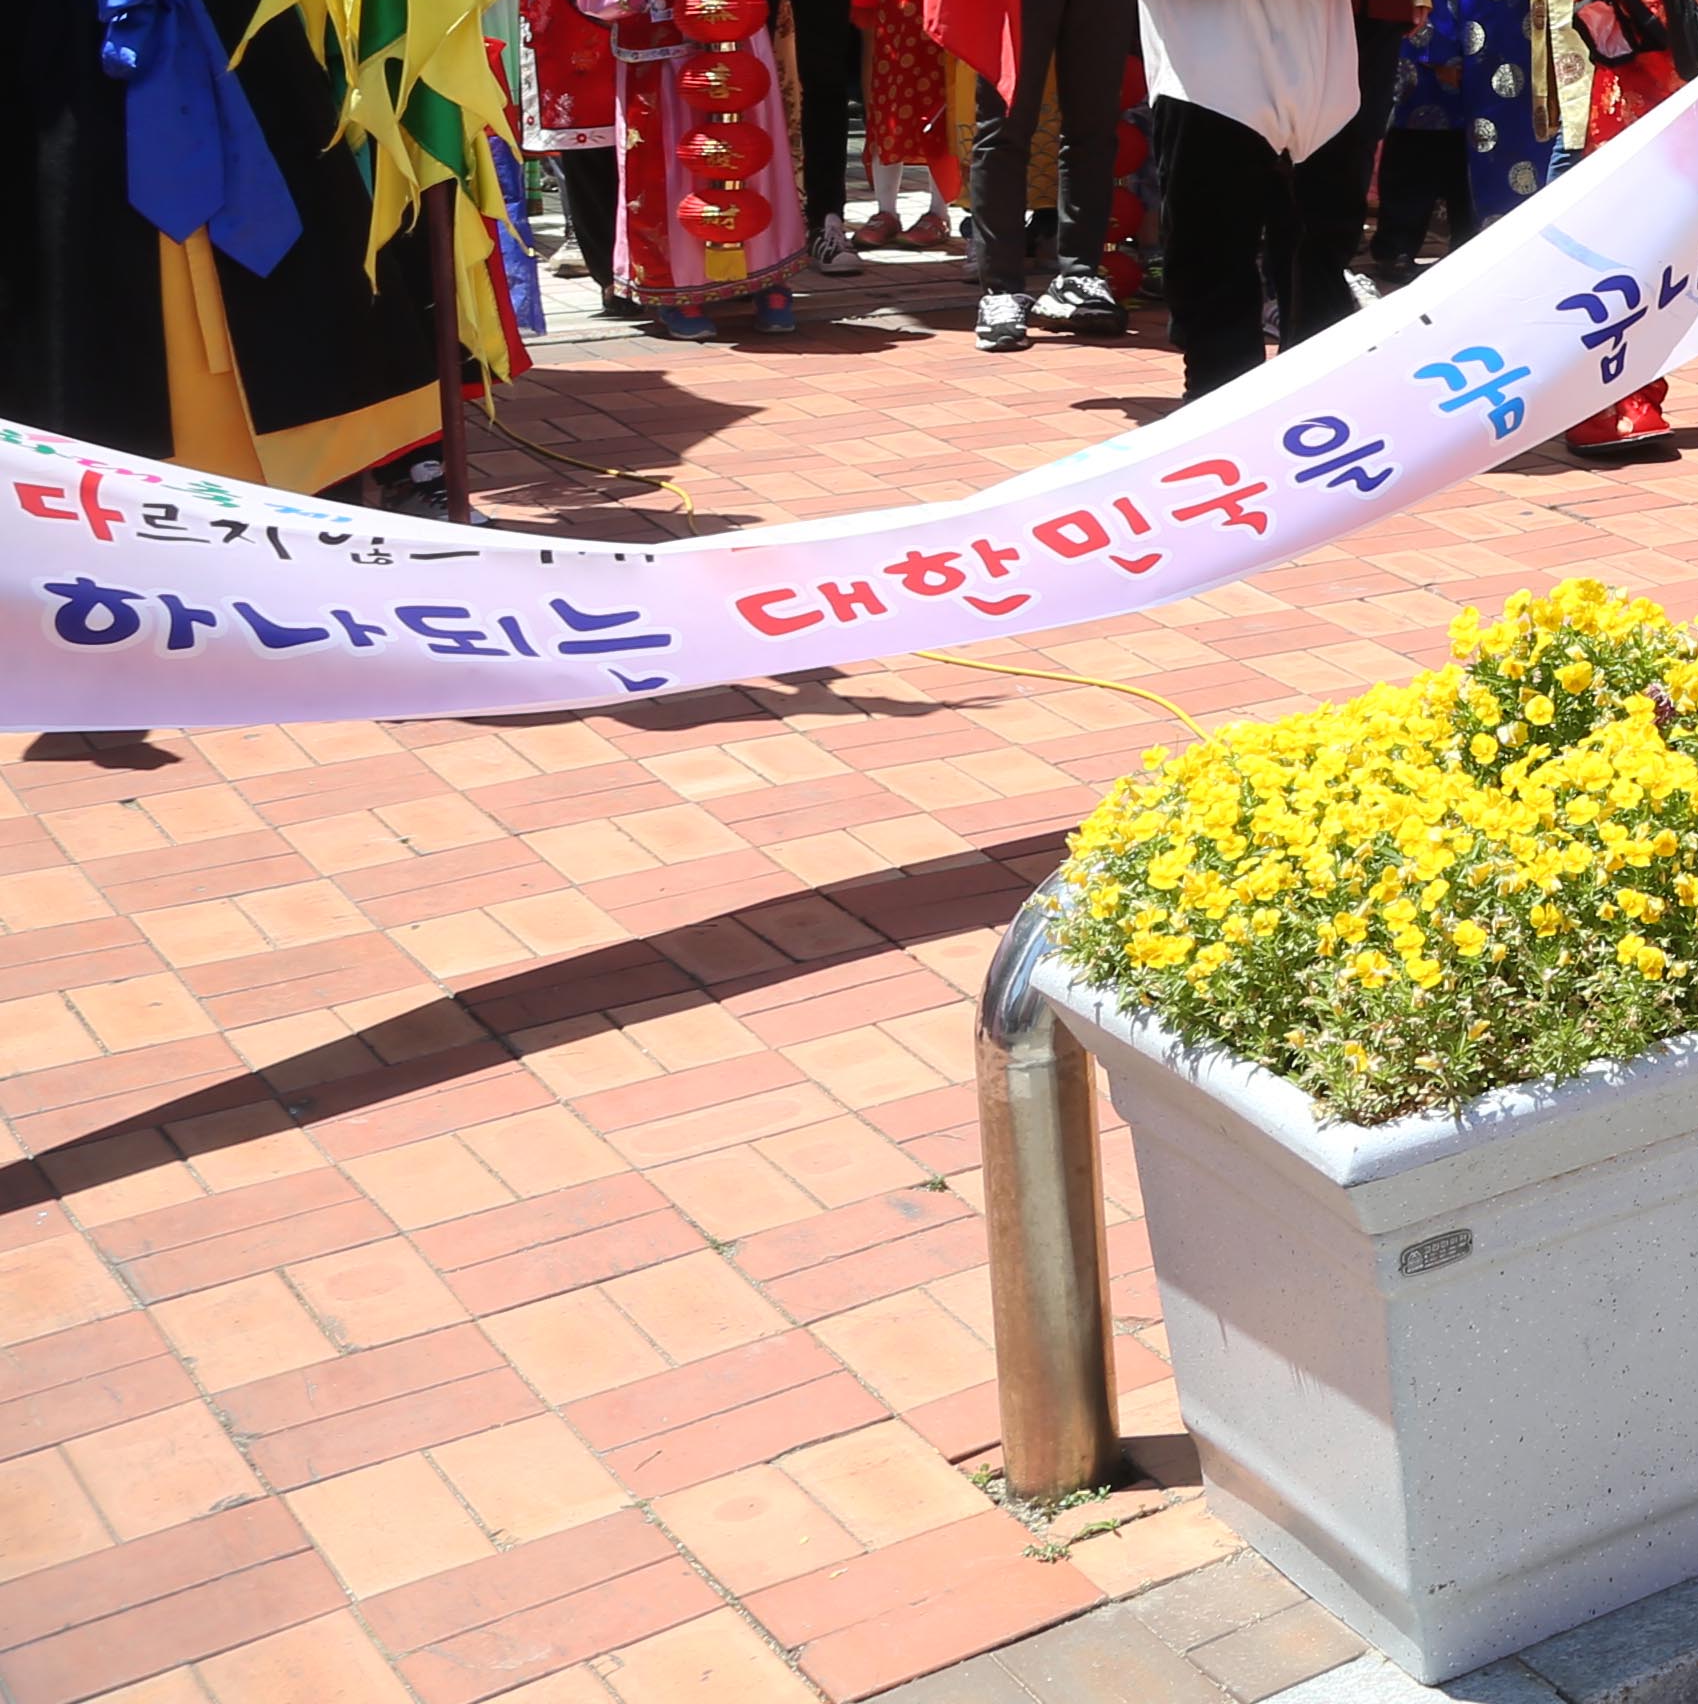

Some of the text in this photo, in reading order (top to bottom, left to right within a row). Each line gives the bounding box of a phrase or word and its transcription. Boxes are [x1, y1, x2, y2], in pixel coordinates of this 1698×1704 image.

[14, 469, 293, 561] 다르지
[44, 577, 672, 692] 하나되는
[734, 415, 1395, 637] 대한민국을
[1413, 346, 1531, 441] 꿈
